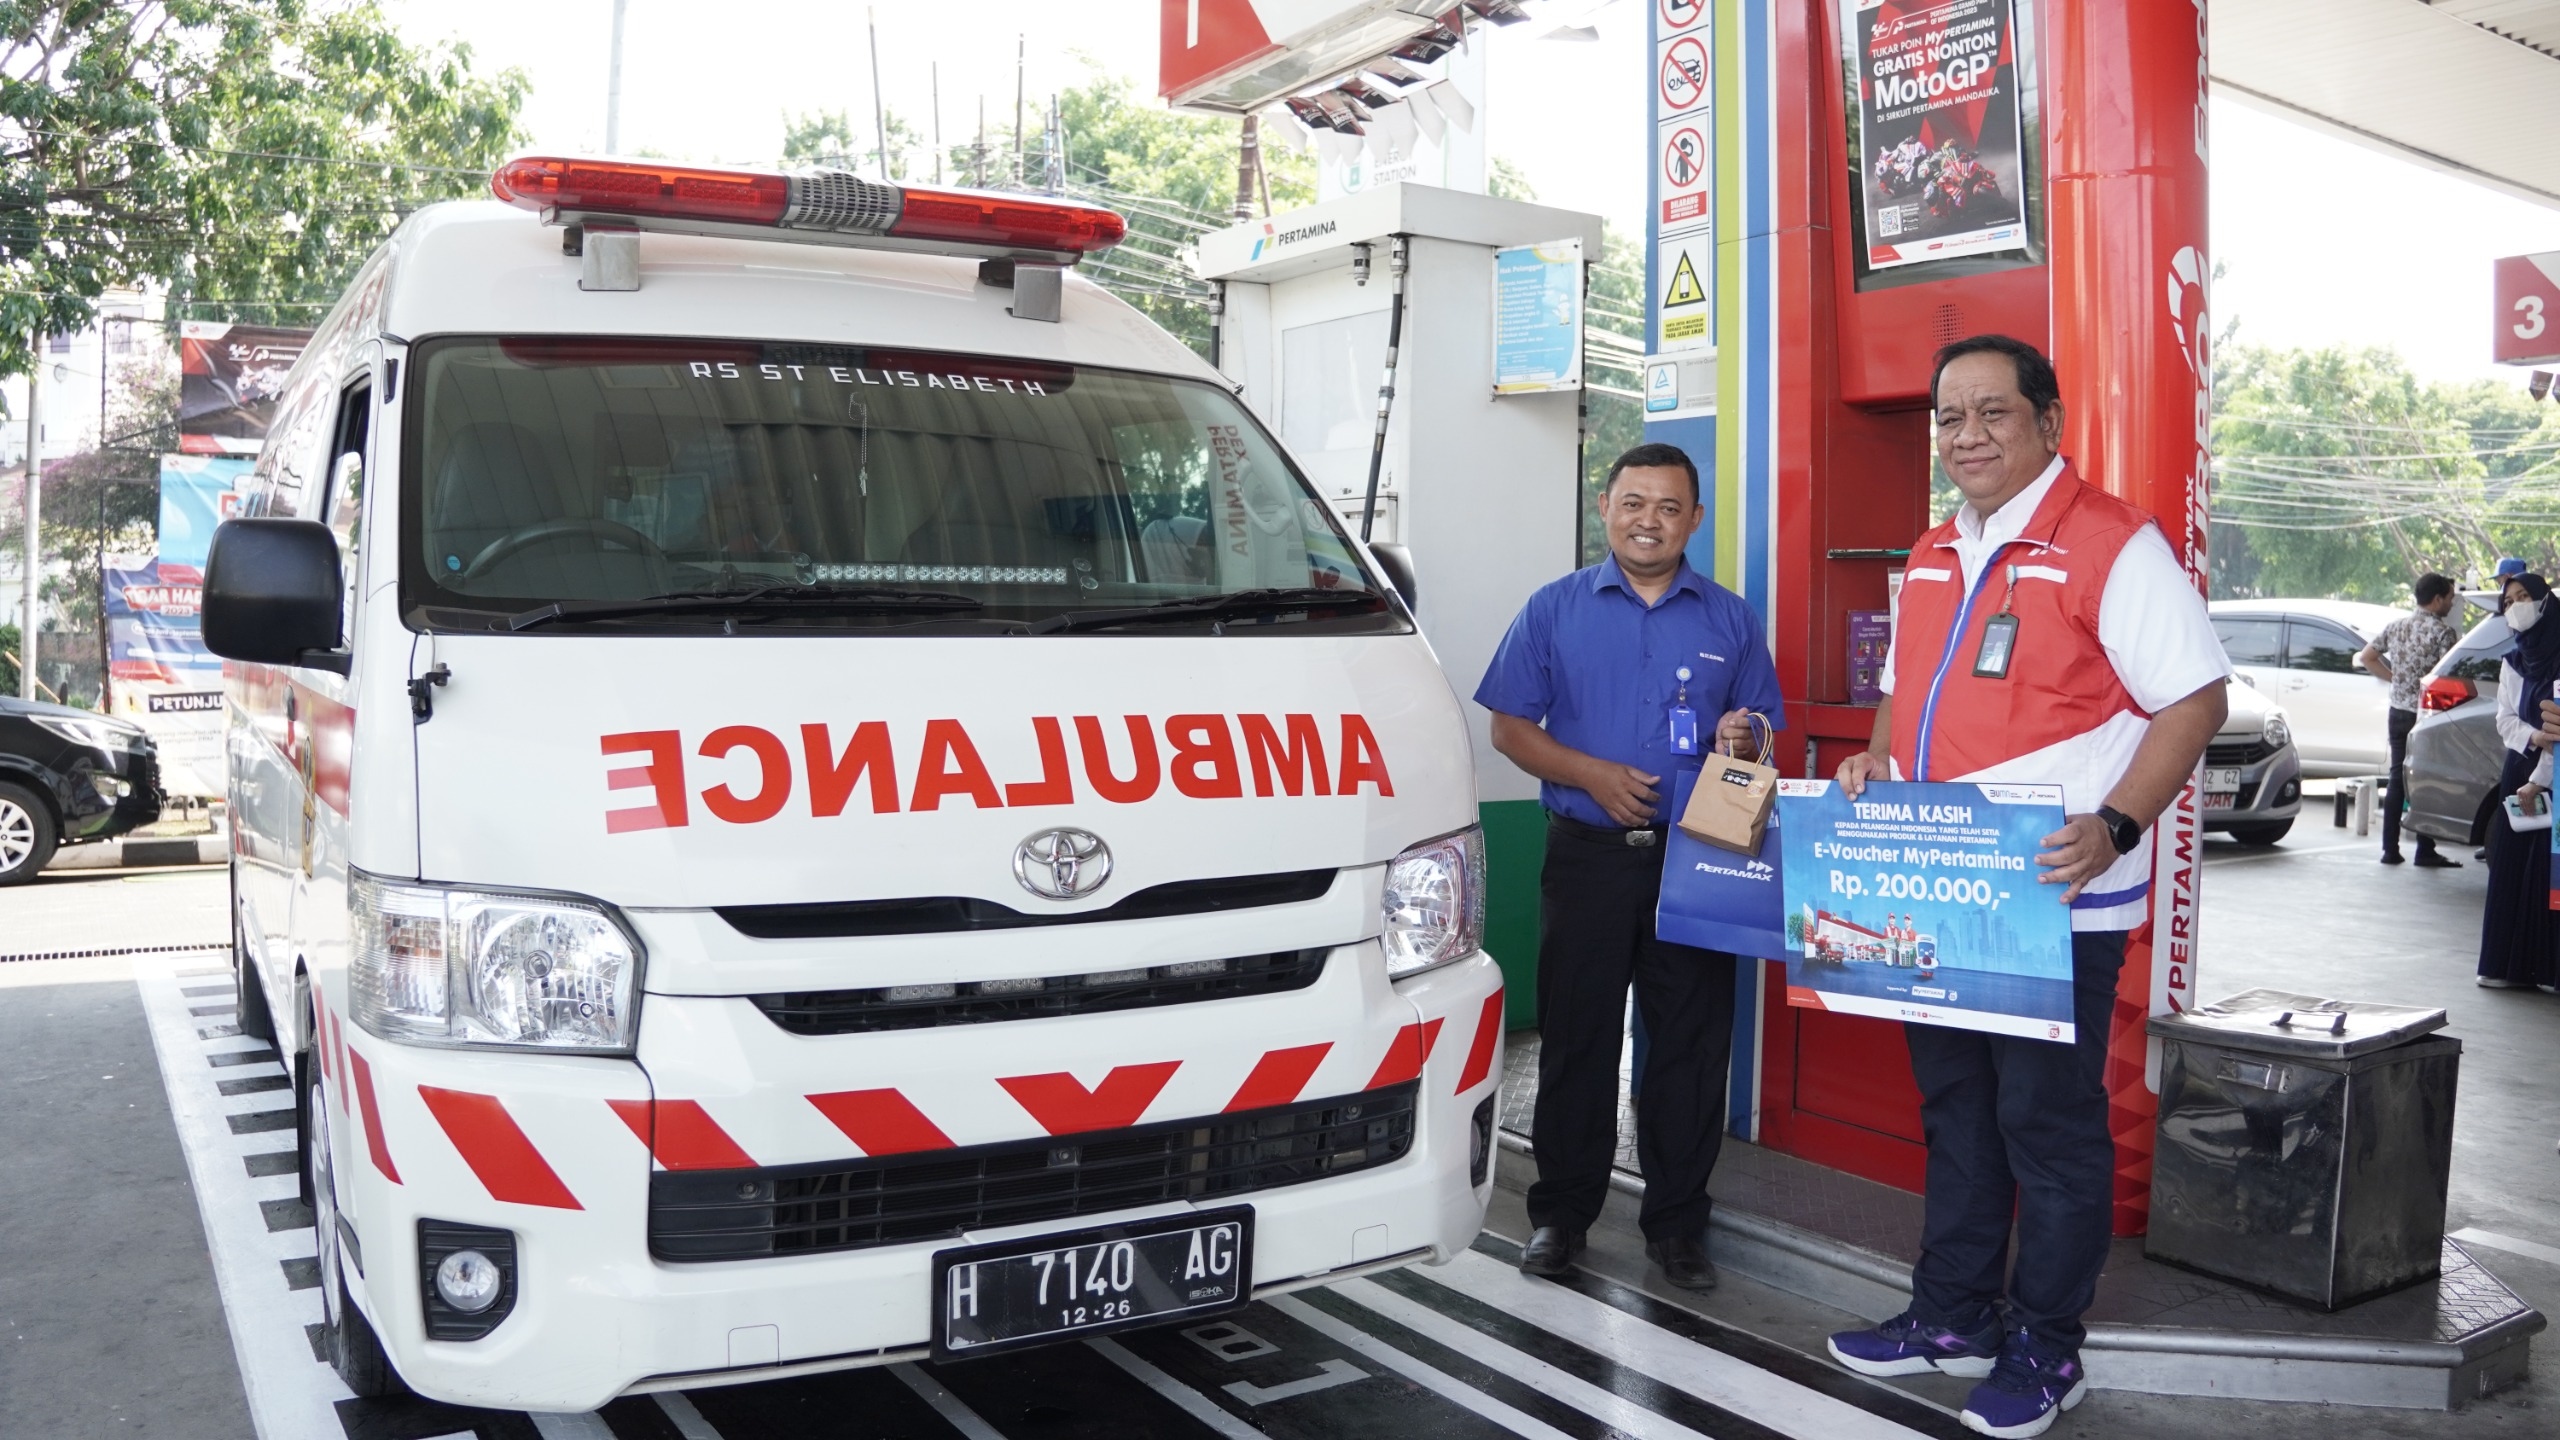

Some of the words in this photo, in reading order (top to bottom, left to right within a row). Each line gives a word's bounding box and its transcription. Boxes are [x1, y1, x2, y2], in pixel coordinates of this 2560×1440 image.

[1872, 45, 1899, 58] TUKAR
[1901, 37, 1922, 51] POIN
[1925, 16, 1995, 46] MyPERTAMINA
[1873, 51, 1924, 77] GRATIS
[1927, 31, 1996, 63] NONTON
[1877, 114, 1885, 123] DI
[1886, 107, 1911, 121] SIRKUIT
[1912, 98, 1953, 115] PERTAMINA
[1955, 86, 2000, 105] MANDALIKA
[1374, 165, 1416, 186] STATION
[1278, 220, 1337, 246] PERTAMINA
[2513, 295, 2546, 340] 3
[689, 361, 740, 379] RS
[760, 363, 804, 381] ST
[829, 366, 1047, 397] ELISABETH
[2194, 312, 2210, 592] URBO
[165, 607, 190, 615] 2023
[2224, 770, 2238, 784] GZ
[1853, 802, 1914, 822] TERIMA
[1919, 804, 1972, 824] KASIH
[1834, 821, 1860, 830] KEPADA
[1860, 822, 1900, 832] PELANGGAN
[1901, 824, 1936, 833] INDONESIA
[1938, 826, 1959, 835] YANG
[1960, 827, 1981, 836] TELAH
[1982, 828, 2000, 836] SETIA
[1836, 830, 1888, 840] MENGGUNAKAN
[1889, 831, 1916, 841] PRODUK
[1917, 833, 1923, 841] &
[1924, 833, 1957, 843] LAYANAN
[1958, 835, 1998, 845] PERTAMINA
[1814, 842, 1900, 863] E-Voucher
[1903, 846, 2025, 871] MyPertamina
[1695, 862, 1774, 882] PERTAMAX
[1830, 869, 1869, 899] Rp.
[1875, 872, 2011, 911] 200.000,-
[952, 1263, 979, 1320] H
[1031, 1241, 1135, 1306] 7140
[1184, 1226, 1233, 1281] AG
